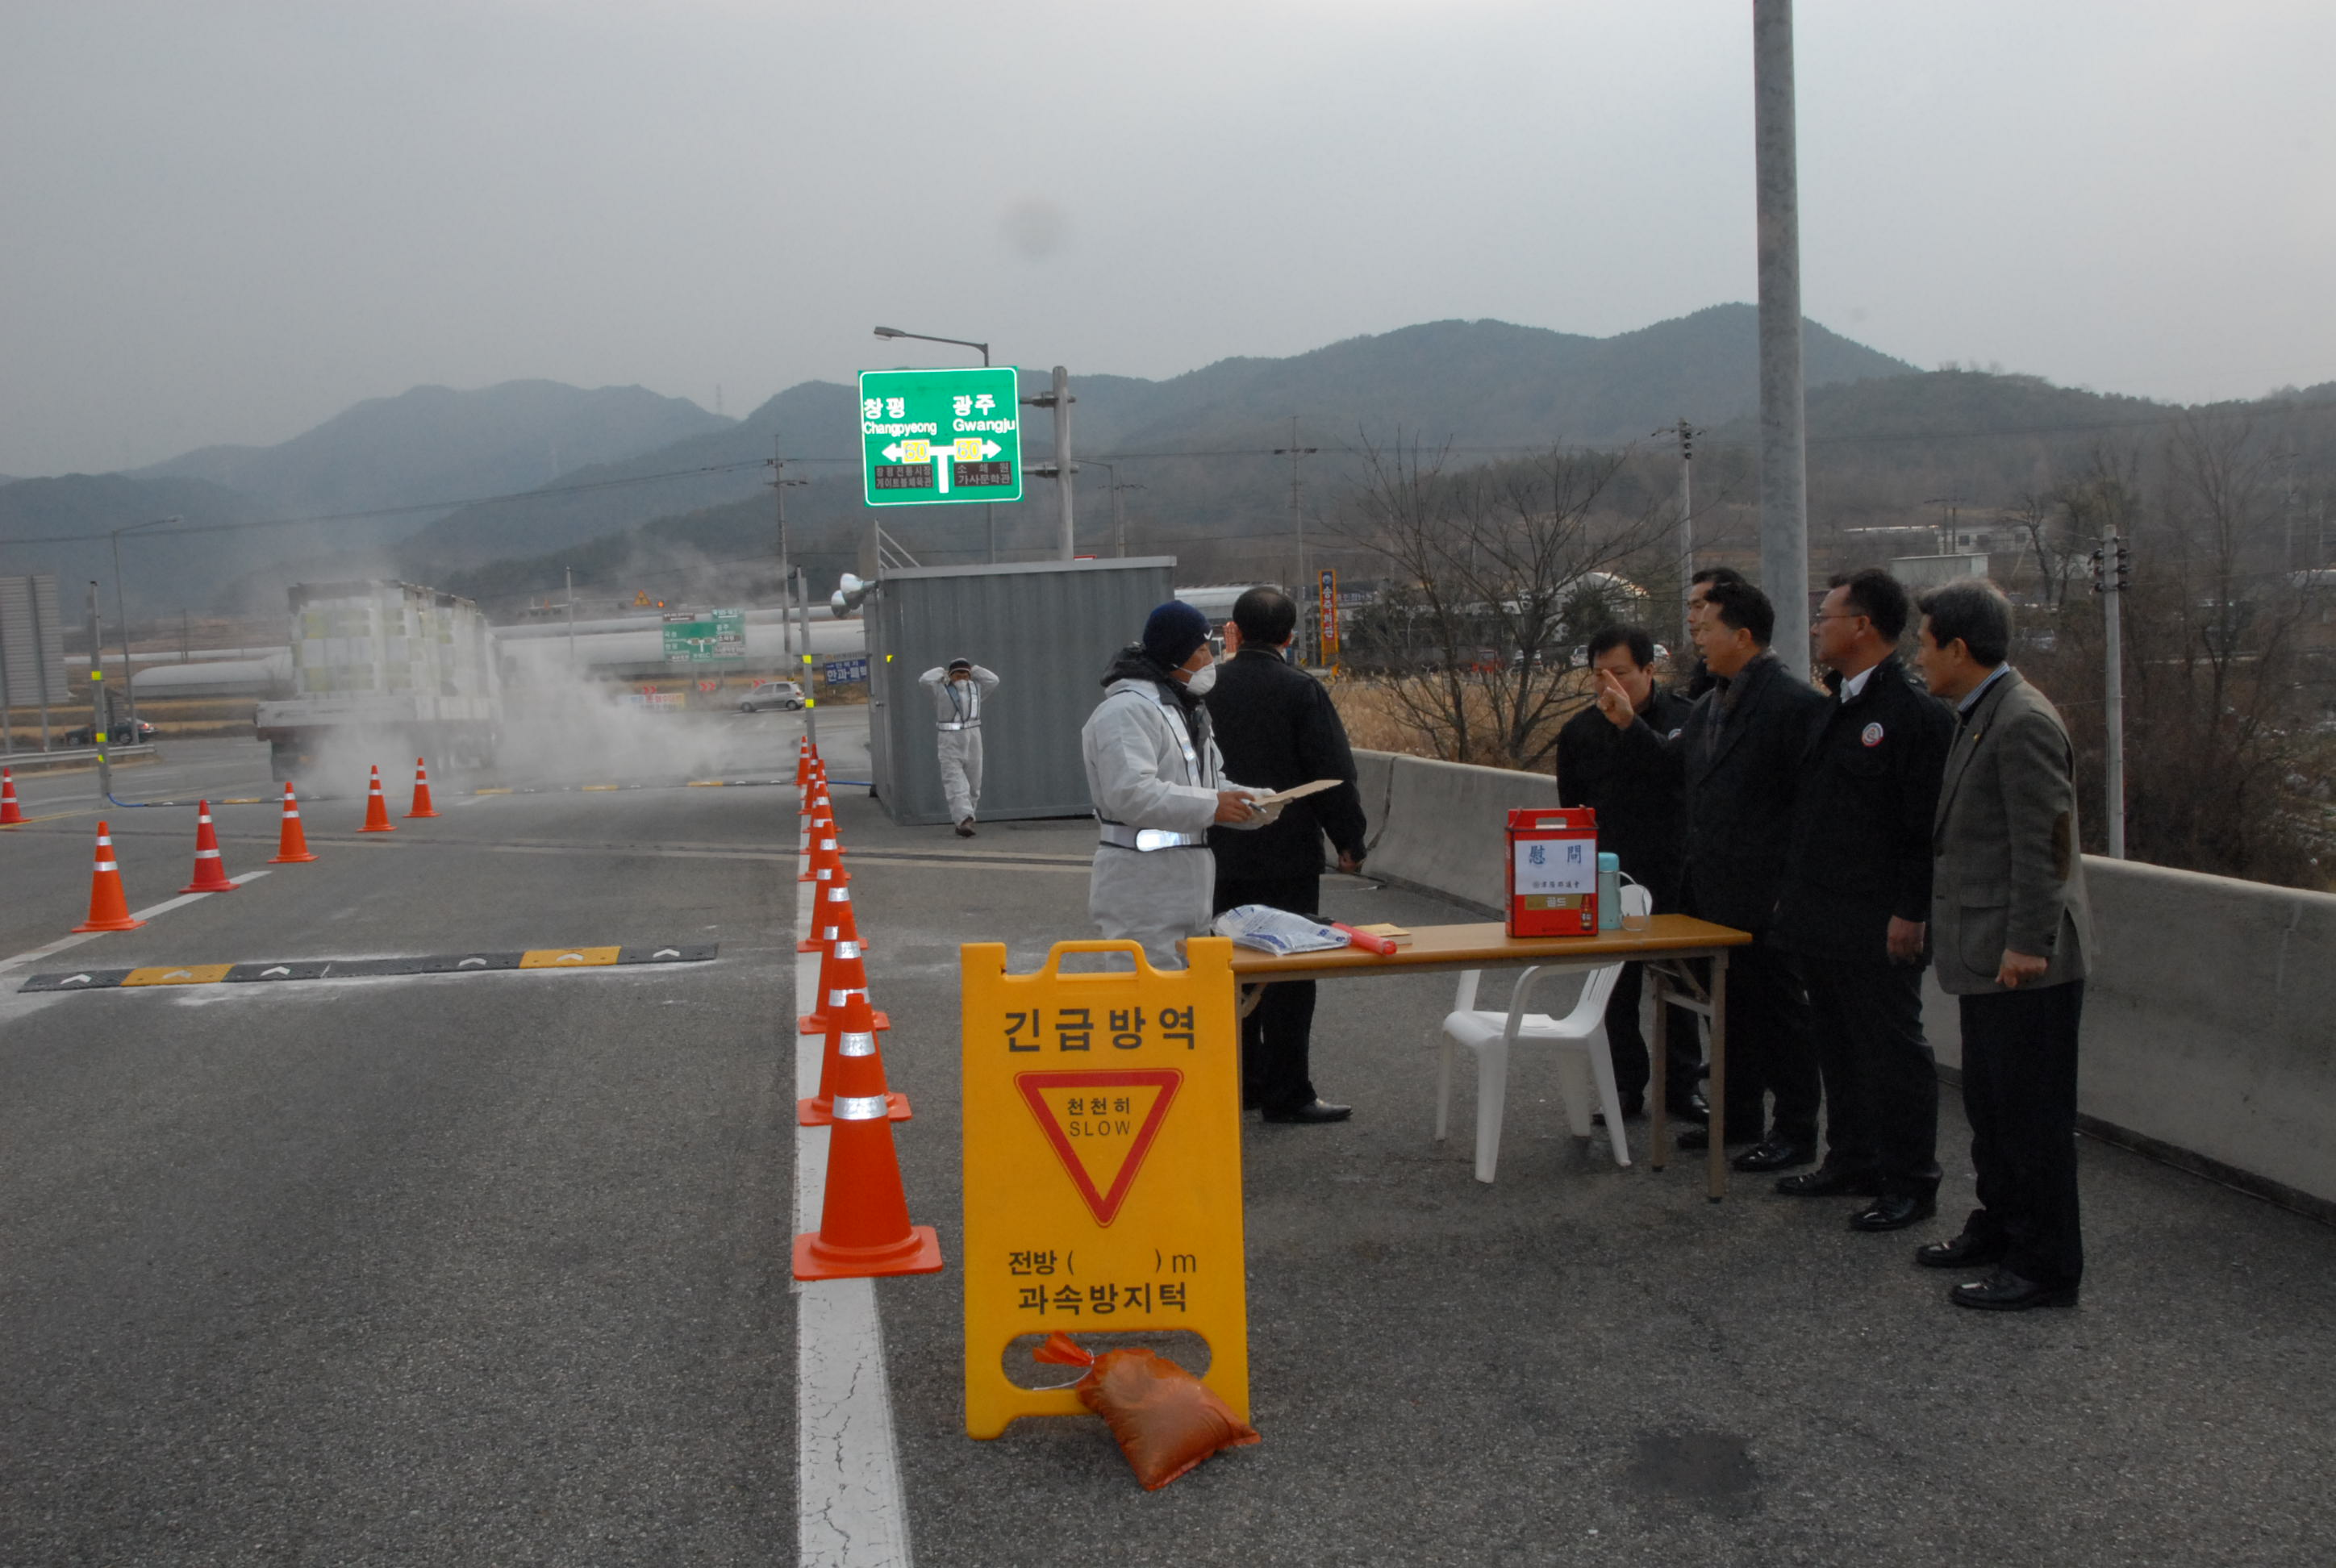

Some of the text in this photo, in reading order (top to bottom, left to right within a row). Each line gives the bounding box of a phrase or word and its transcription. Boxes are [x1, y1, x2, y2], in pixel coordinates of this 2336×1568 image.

[864, 397, 905, 419] 창평
[953, 394, 995, 416] 광주
[864, 421, 937, 436] Changpyeong
[953, 418, 1016, 433] Gwangju
[904, 444, 927, 460] 60
[957, 442, 980, 458] 60
[957, 473, 1011, 485] 가사문학관
[1004, 1006, 1195, 1052] 긴급방역
[1067, 1097, 1130, 1116] 천천히
[1070, 1120, 1130, 1136] SLOW
[1019, 1282, 1186, 1316] 과속방지턱
